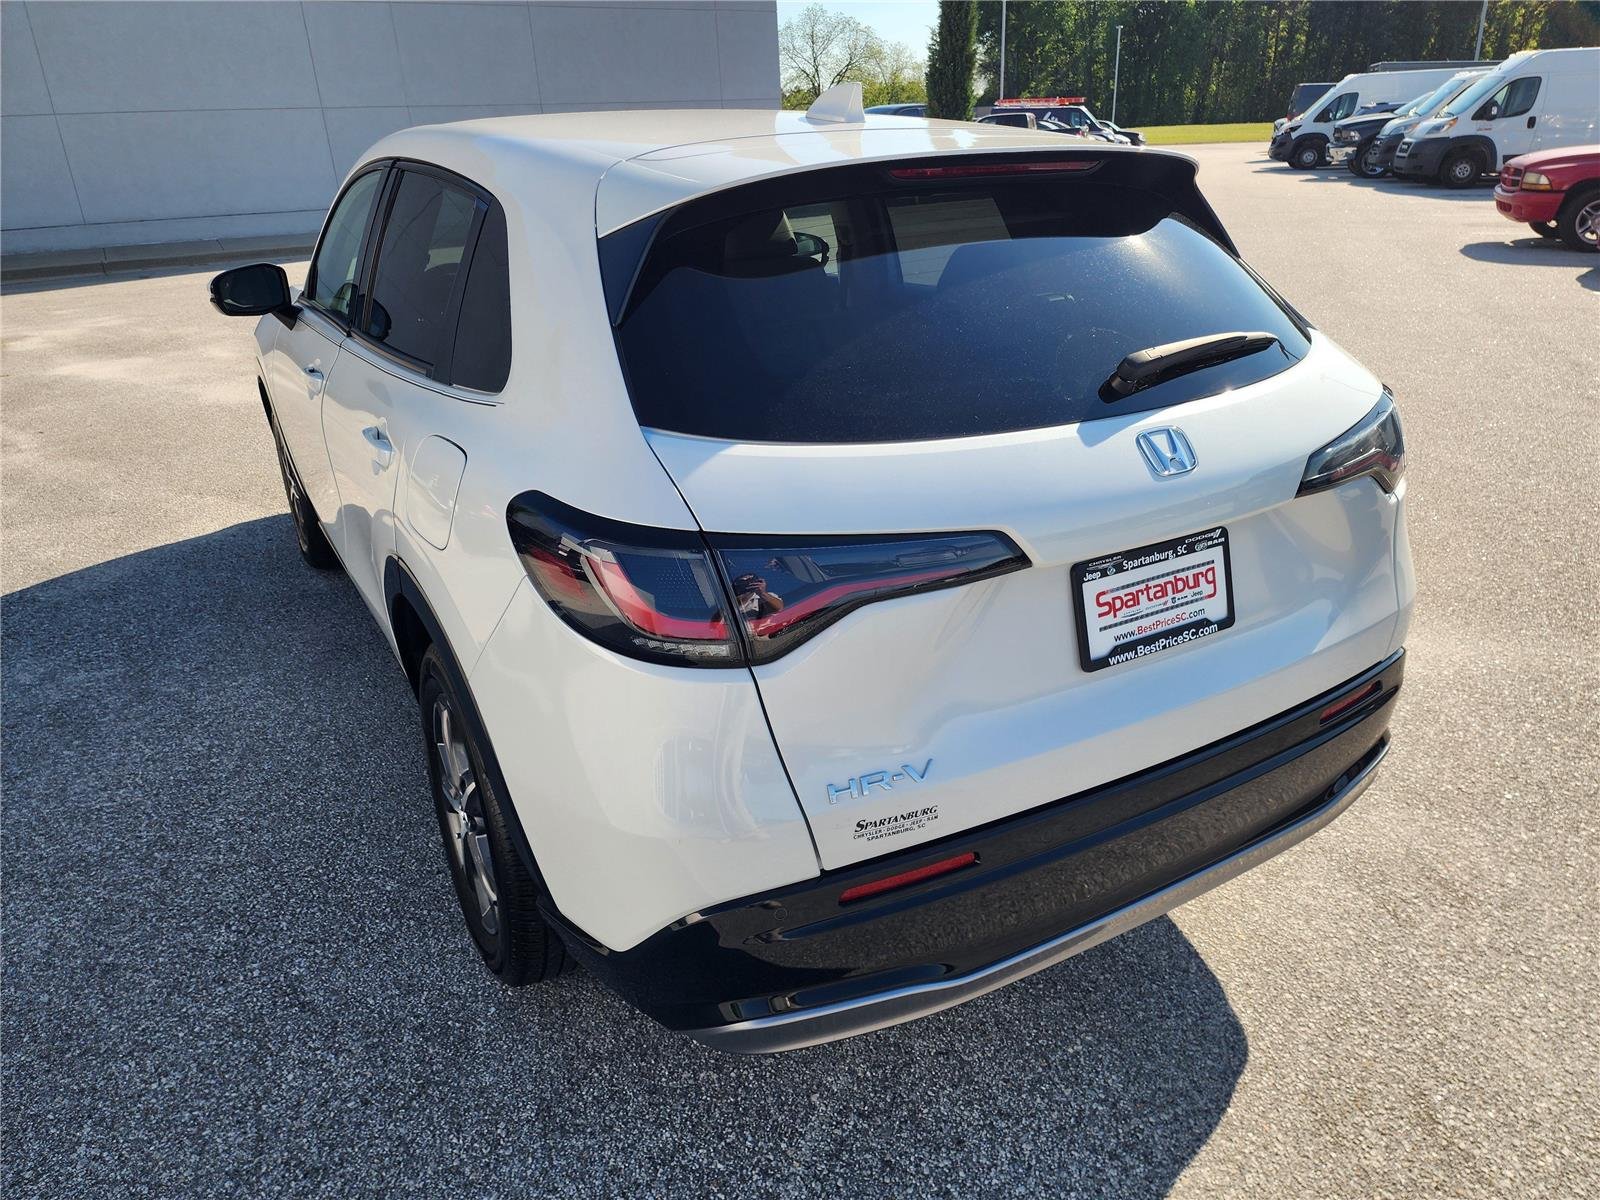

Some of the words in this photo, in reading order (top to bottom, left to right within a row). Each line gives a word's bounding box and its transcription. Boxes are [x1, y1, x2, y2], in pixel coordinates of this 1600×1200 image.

[1207, 537, 1225, 546] RAM
[1122, 549, 1176, 571] Spartanburg,
[1177, 544, 1188, 555] SC
[1083, 571, 1101, 582] Jeep
[1095, 566, 1217, 619] Spartanburg
[1113, 607, 1206, 642] www.BestPriceSC.com
[1108, 623, 1218, 666] www.BestPriceSC.com
[826, 758, 933, 805] HR-V
[853, 829, 883, 840] CHRYSLER
[886, 824, 905, 832] DODGE
